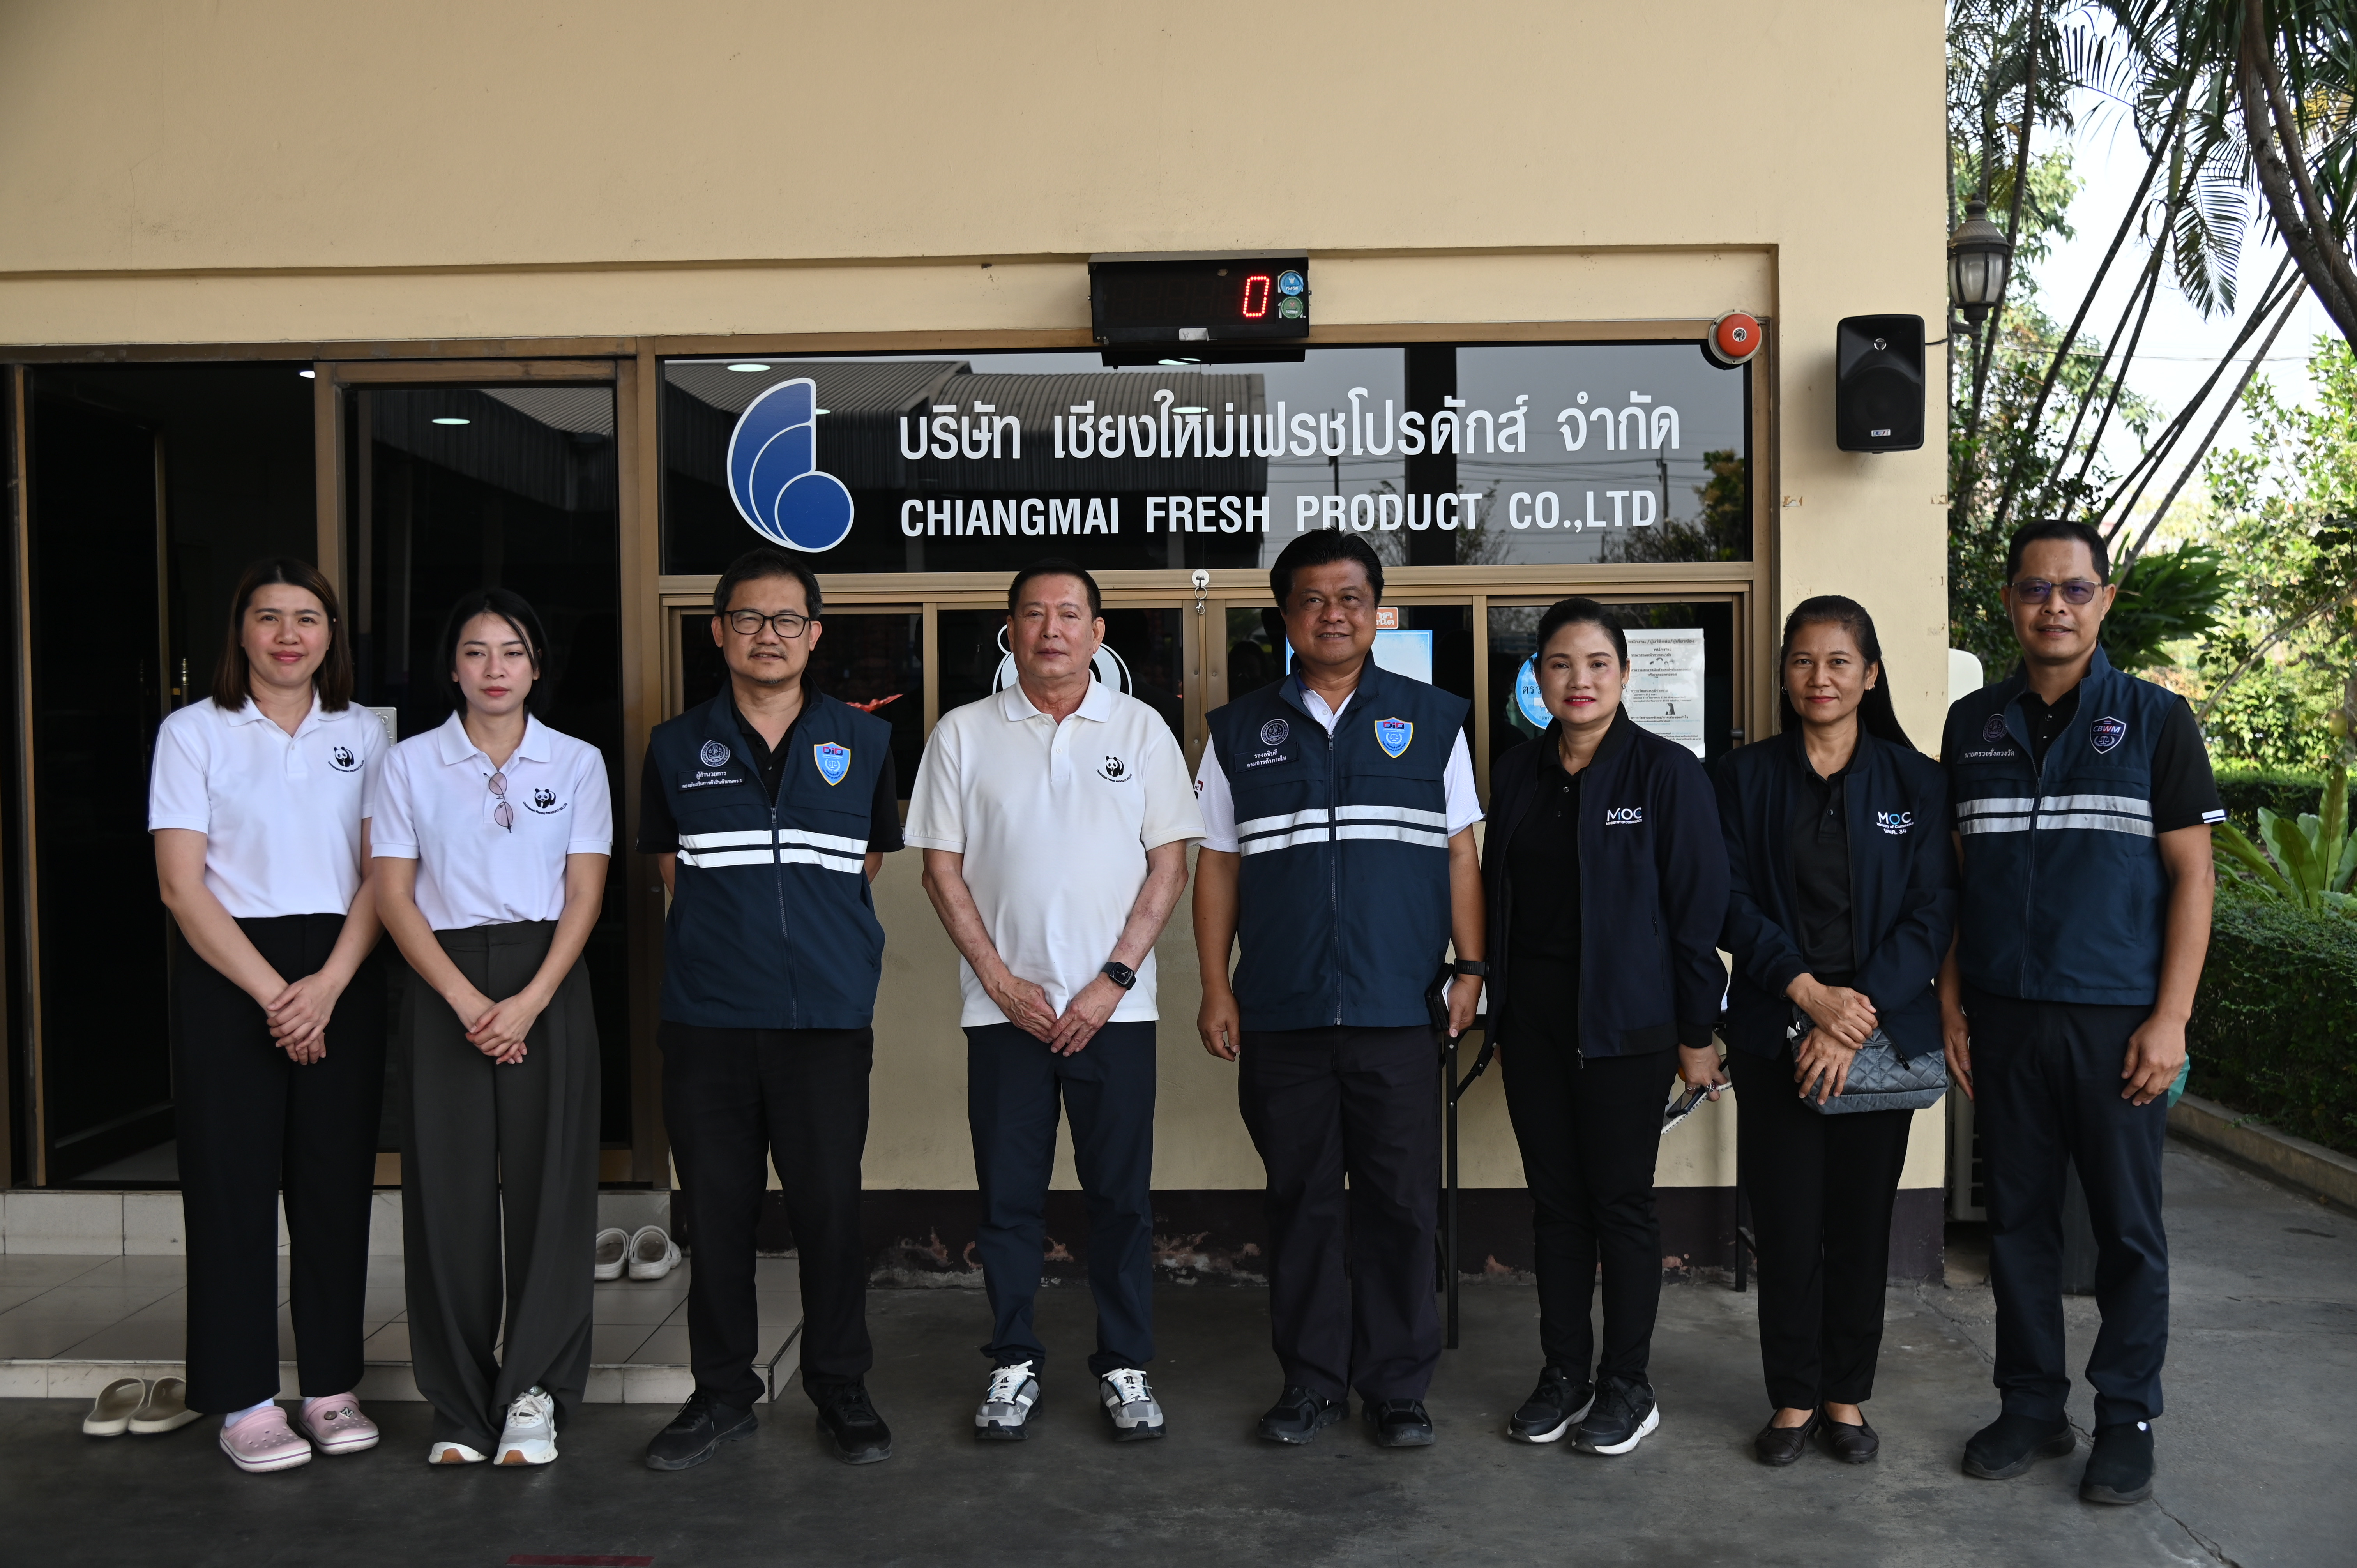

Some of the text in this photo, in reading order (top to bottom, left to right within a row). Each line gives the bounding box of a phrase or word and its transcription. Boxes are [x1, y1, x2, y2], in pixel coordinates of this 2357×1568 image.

[1243, 276, 1269, 317] 0
[900, 387, 1679, 460] บริษัท เชียงใหม่เฟรชโปรดักส์ จำกัด
[901, 490, 1656, 537] CHIANGMAI FRESH PRODUCT CO.,LTD
[1522, 685, 1542, 695] ตรว
[1254, 749, 1278, 758] รองอธิบดี
[1965, 747, 2015, 758] นายตรวจชั่งตวงวัด
[1247, 755, 1286, 768] กรมการค้าภายใน
[696, 771, 727, 780] ผู้อำนวยการ
[1606, 807, 1642, 822] MOC
[1878, 811, 1912, 825] MOC
